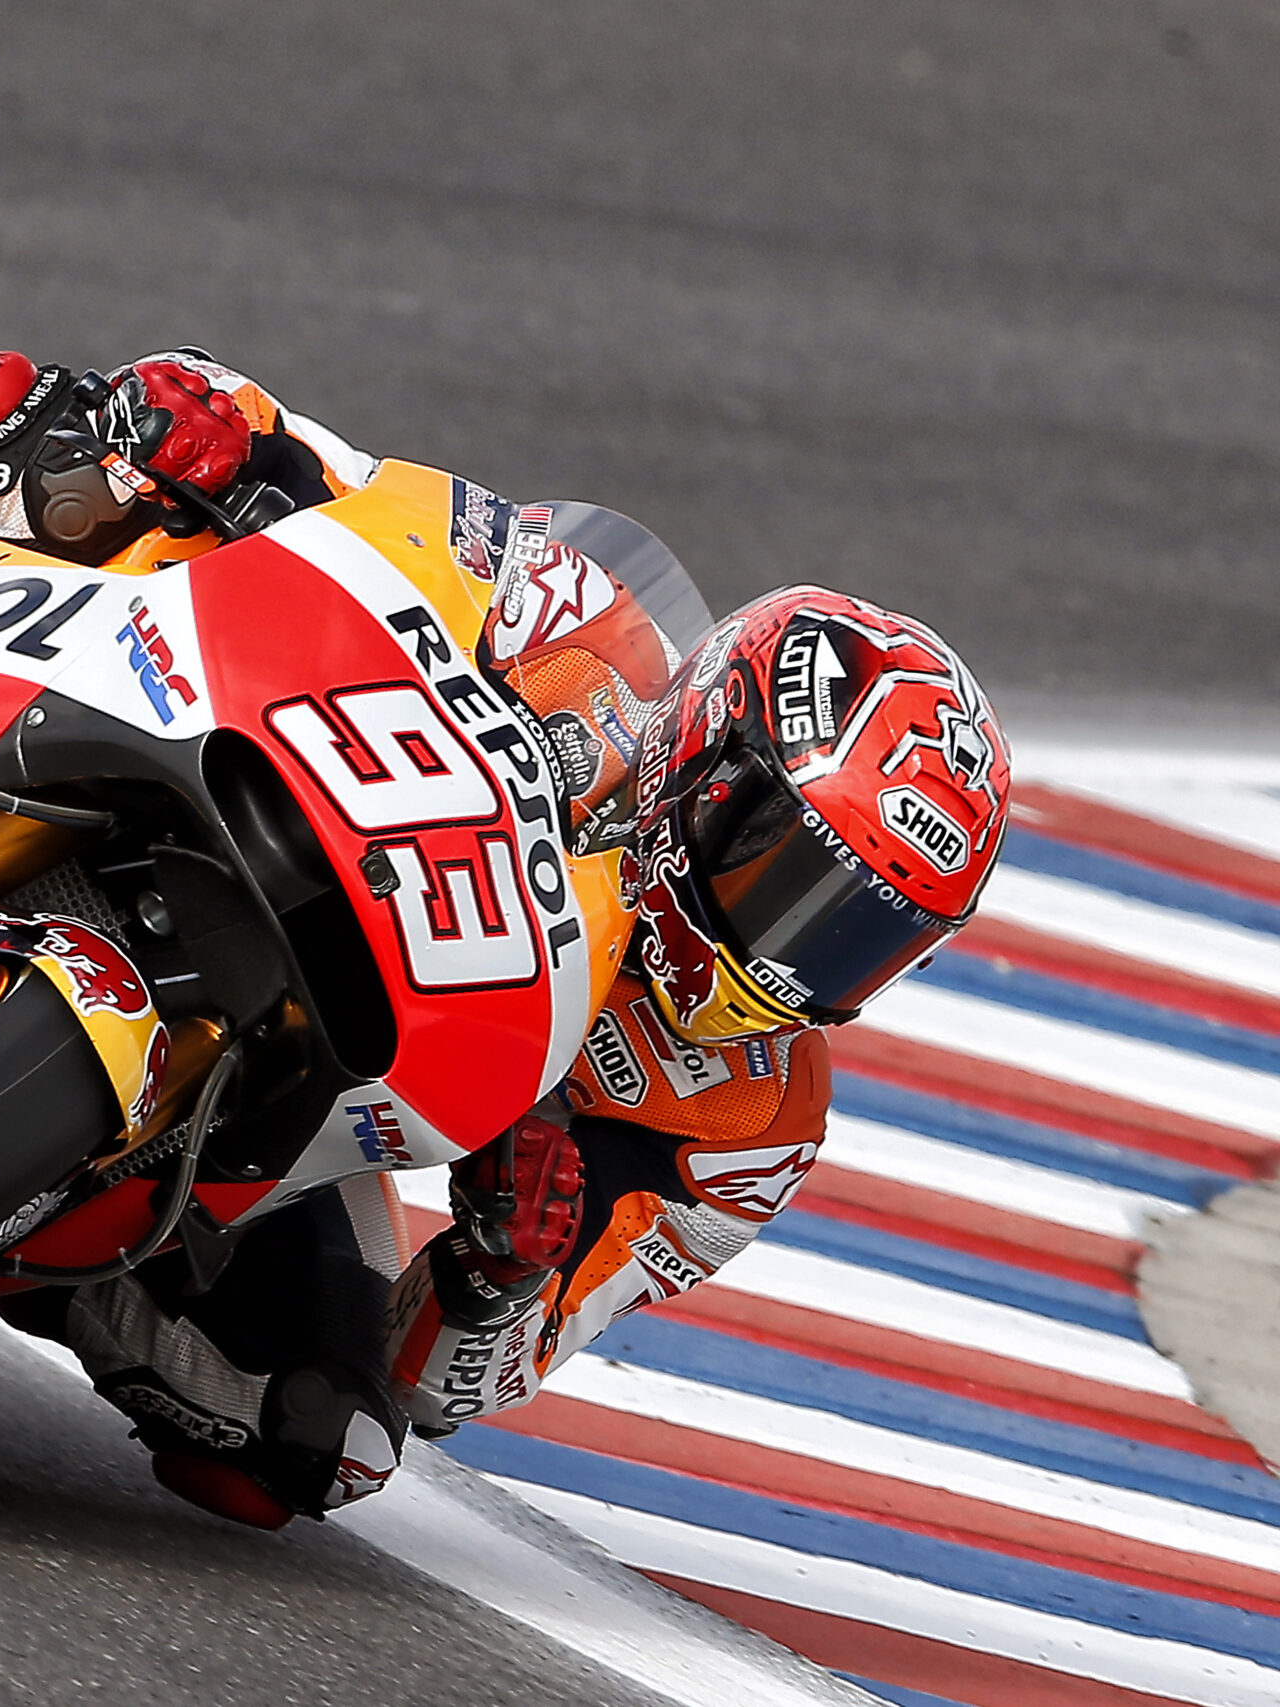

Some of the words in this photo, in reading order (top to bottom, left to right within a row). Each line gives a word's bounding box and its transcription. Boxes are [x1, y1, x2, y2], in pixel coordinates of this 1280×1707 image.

[107, 457, 148, 489] 93
[116, 605, 198, 727] HRC
[778, 630, 818, 744] LOTUS
[386, 605, 581, 971] REPSOL
[511, 701, 566, 801] HONDA
[562, 722, 591, 785] Estrella
[265, 682, 539, 991] 93
[802, 809, 861, 871] GIVES
[867, 873, 908, 910] YOU
[892, 797, 963, 866] SHOEI
[745, 958, 806, 1008] LOTUS
[468, 1270, 502, 1299] 93
